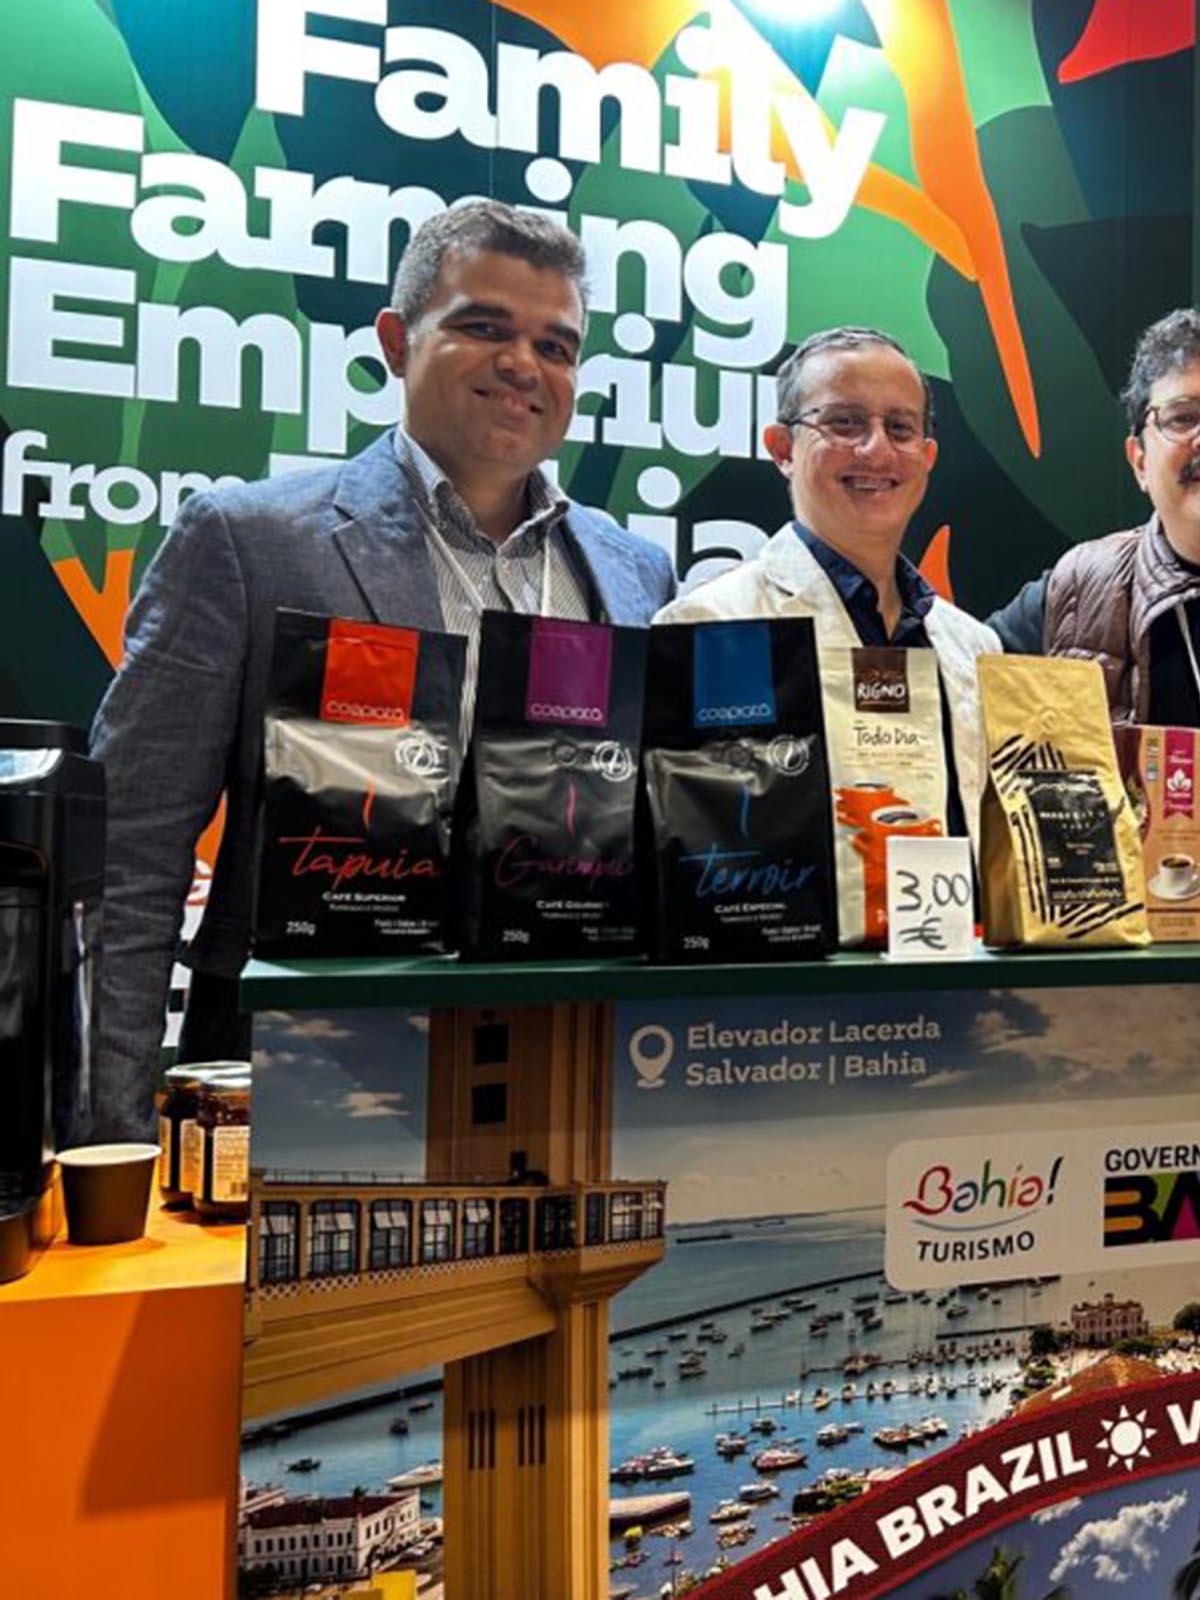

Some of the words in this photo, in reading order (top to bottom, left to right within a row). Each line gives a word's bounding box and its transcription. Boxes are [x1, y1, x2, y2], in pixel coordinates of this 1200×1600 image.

[256, 0, 887, 238] Family
[6, 255, 780, 462] Empriu
[852, 725, 892, 747] Todo
[896, 870, 971, 915] 3,00
[899, 917, 947, 951] €
[687, 1020, 822, 1049] Elevador
[829, 1014, 941, 1043] Lacerda
[686, 1055, 822, 1087] Salvador
[844, 1051, 927, 1078] Bahia
[918, 1230, 1035, 1263] TURISMO
[876, 1431, 1088, 1560] BRAZIL
